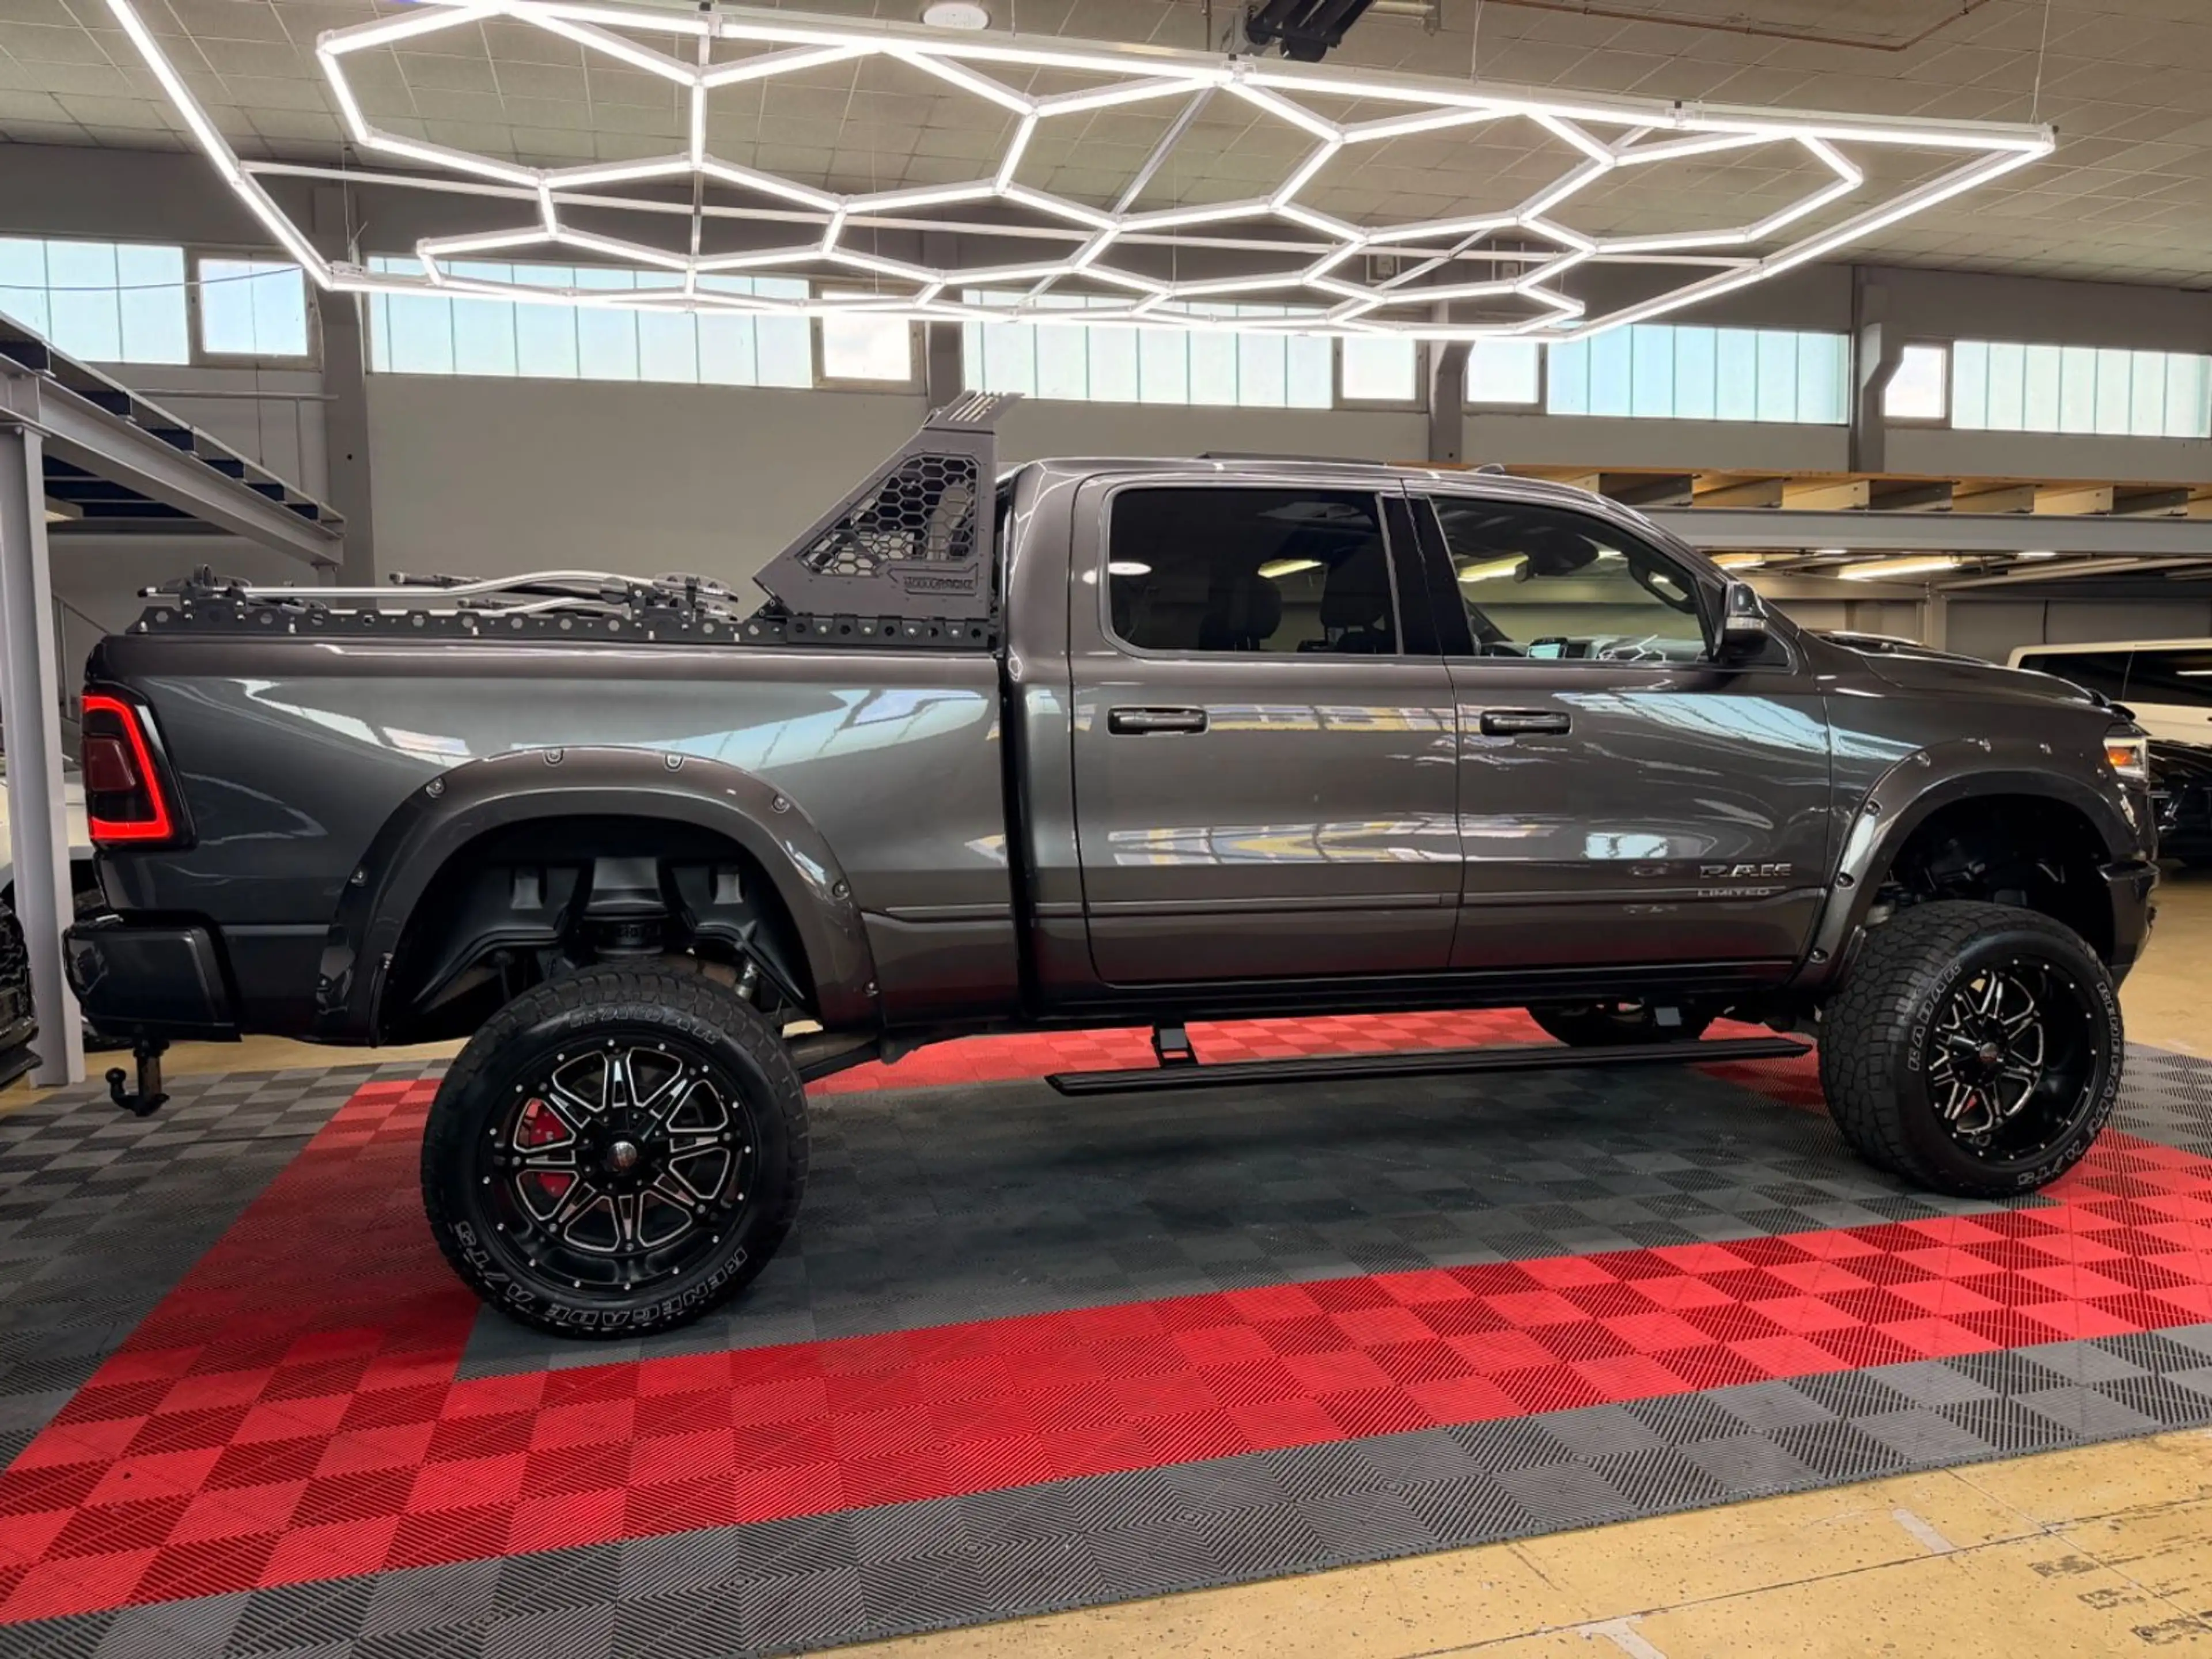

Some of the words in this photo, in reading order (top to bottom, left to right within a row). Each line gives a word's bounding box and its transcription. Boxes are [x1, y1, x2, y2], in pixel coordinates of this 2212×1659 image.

[1699, 863, 1793, 878] RAM
[1697, 888, 1771, 897] LIMITED
[547, 1248, 748, 1327] RENEGADE
